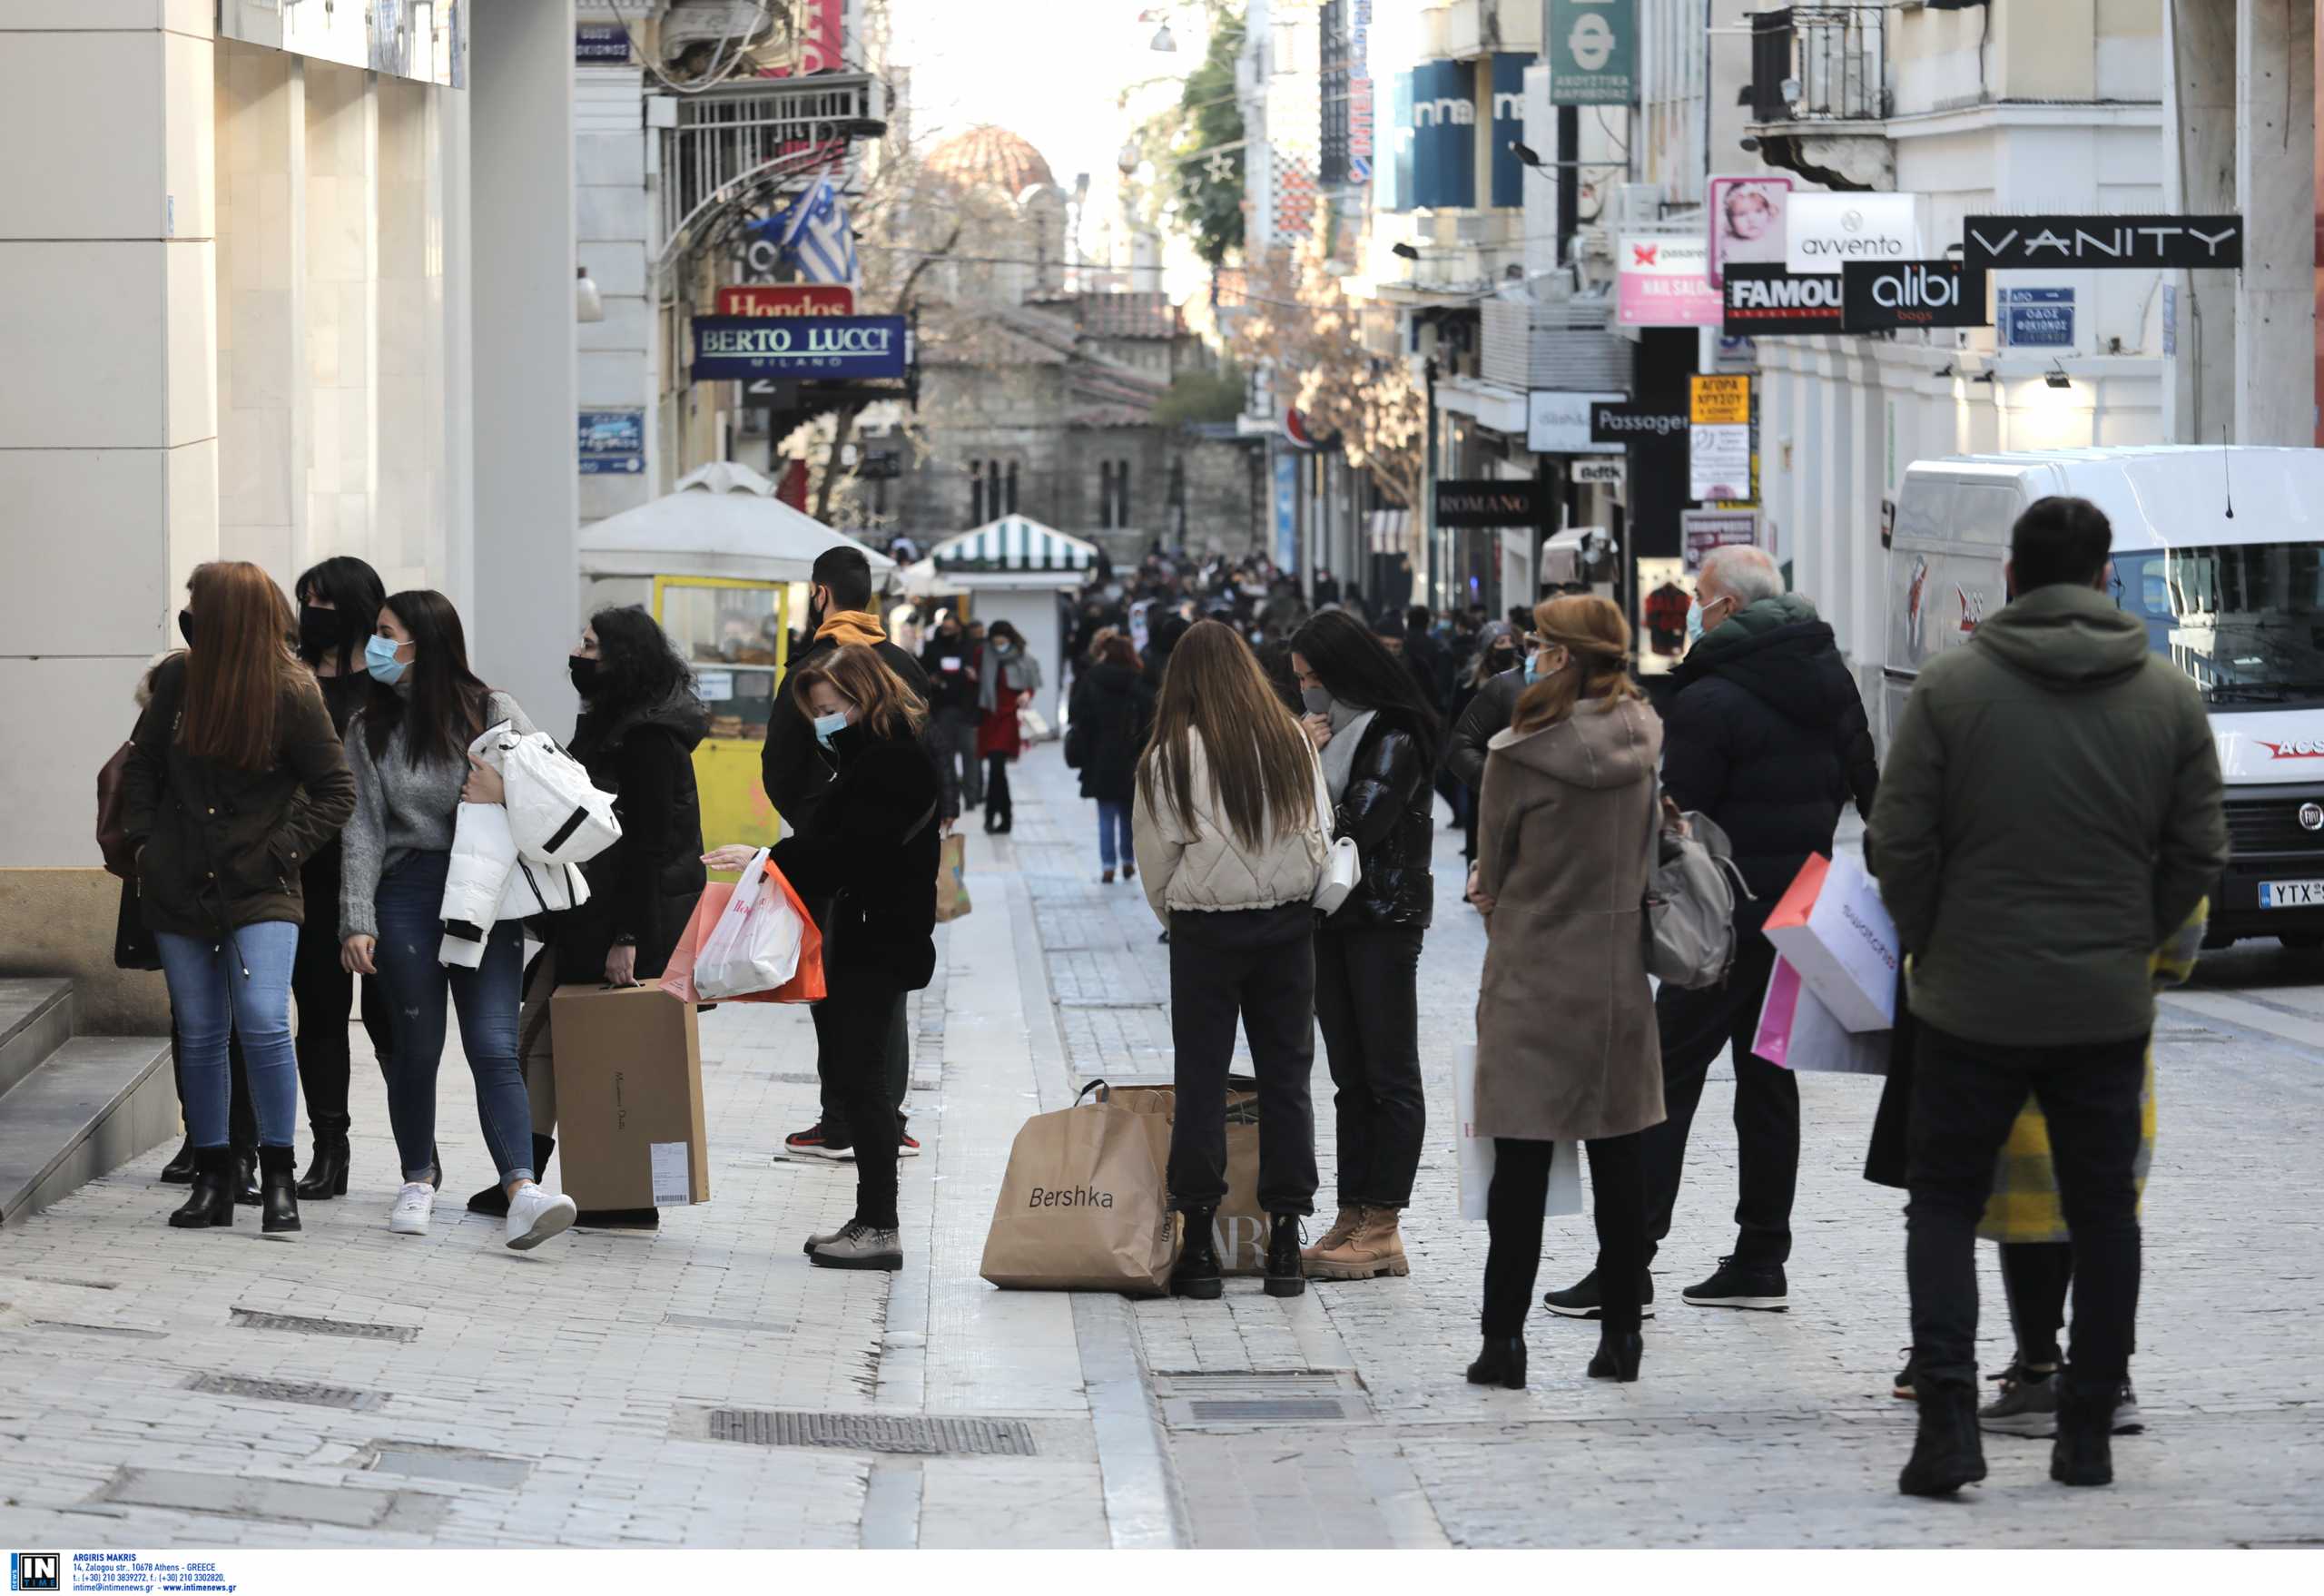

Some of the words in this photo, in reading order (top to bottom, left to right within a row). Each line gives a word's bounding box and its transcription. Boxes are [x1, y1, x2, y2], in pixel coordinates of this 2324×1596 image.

[1801, 234, 1904, 256] avvento
[1970, 227, 2237, 257] VANITY
[1732, 279, 1844, 309] FAMOU
[1871, 263, 1960, 308] alibi
[728, 294, 846, 317] Hondos
[1897, 310, 1934, 323] bags
[701, 328, 793, 352] BERTO
[807, 327, 891, 352] LUCCI
[751, 357, 842, 368] MILANO
[1029, 1184, 1114, 1209] Bershka
